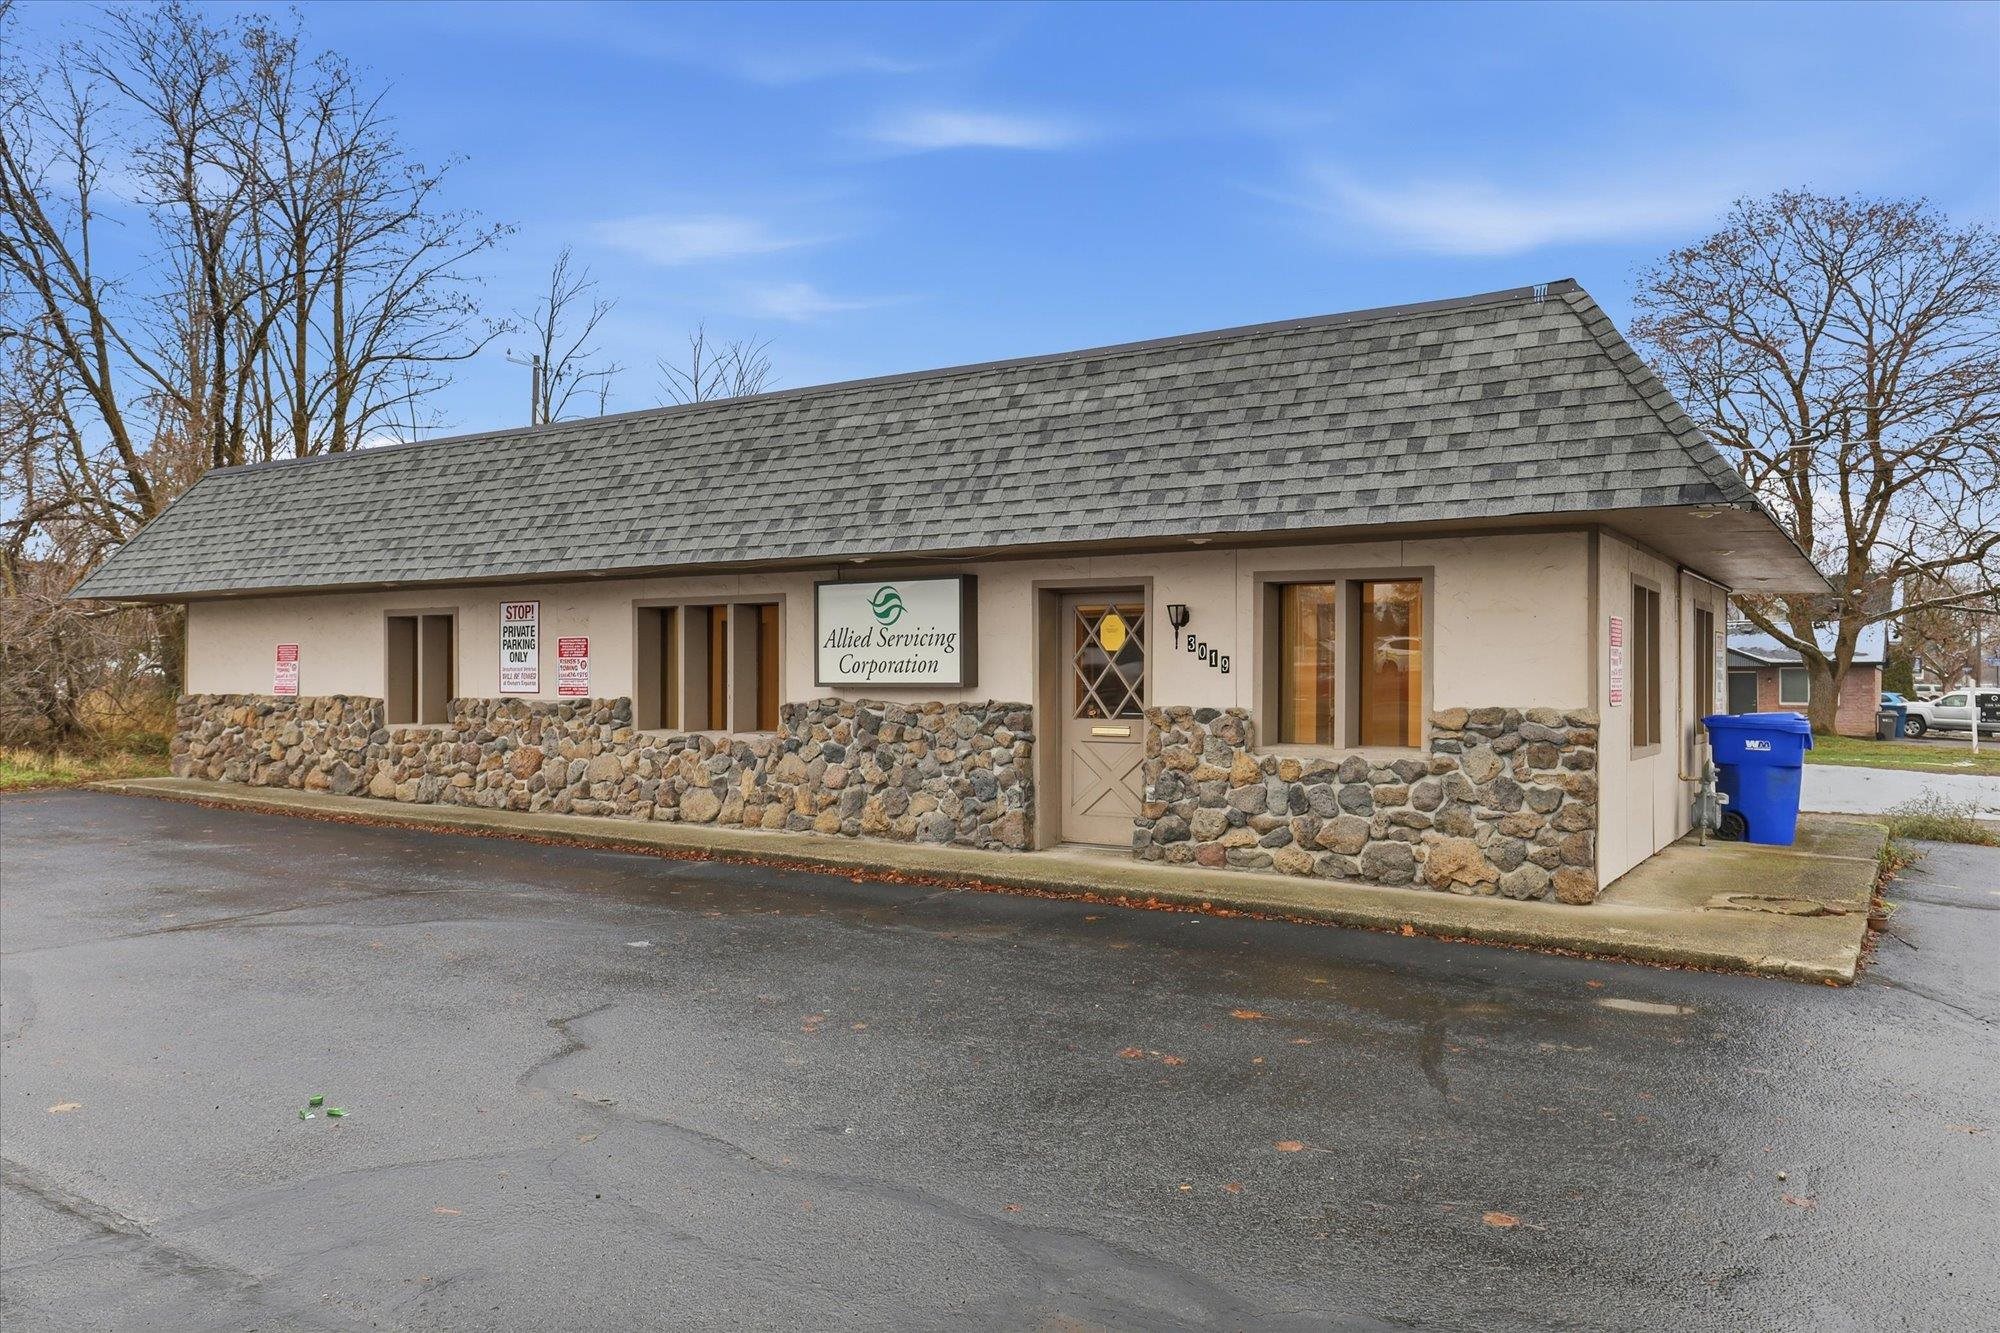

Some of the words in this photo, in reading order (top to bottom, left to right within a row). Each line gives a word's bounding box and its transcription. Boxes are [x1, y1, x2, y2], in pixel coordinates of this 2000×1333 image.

[506, 604, 534, 620] STOP!
[502, 625, 536, 638] PRIVATE
[502, 638, 536, 650] PARKING
[823, 626, 873, 649] Allied
[876, 626, 957, 654] Servicing
[509, 651, 528, 663] ONLY
[1188, 635, 1229, 673] 3019
[839, 653, 939, 680] Corporation
